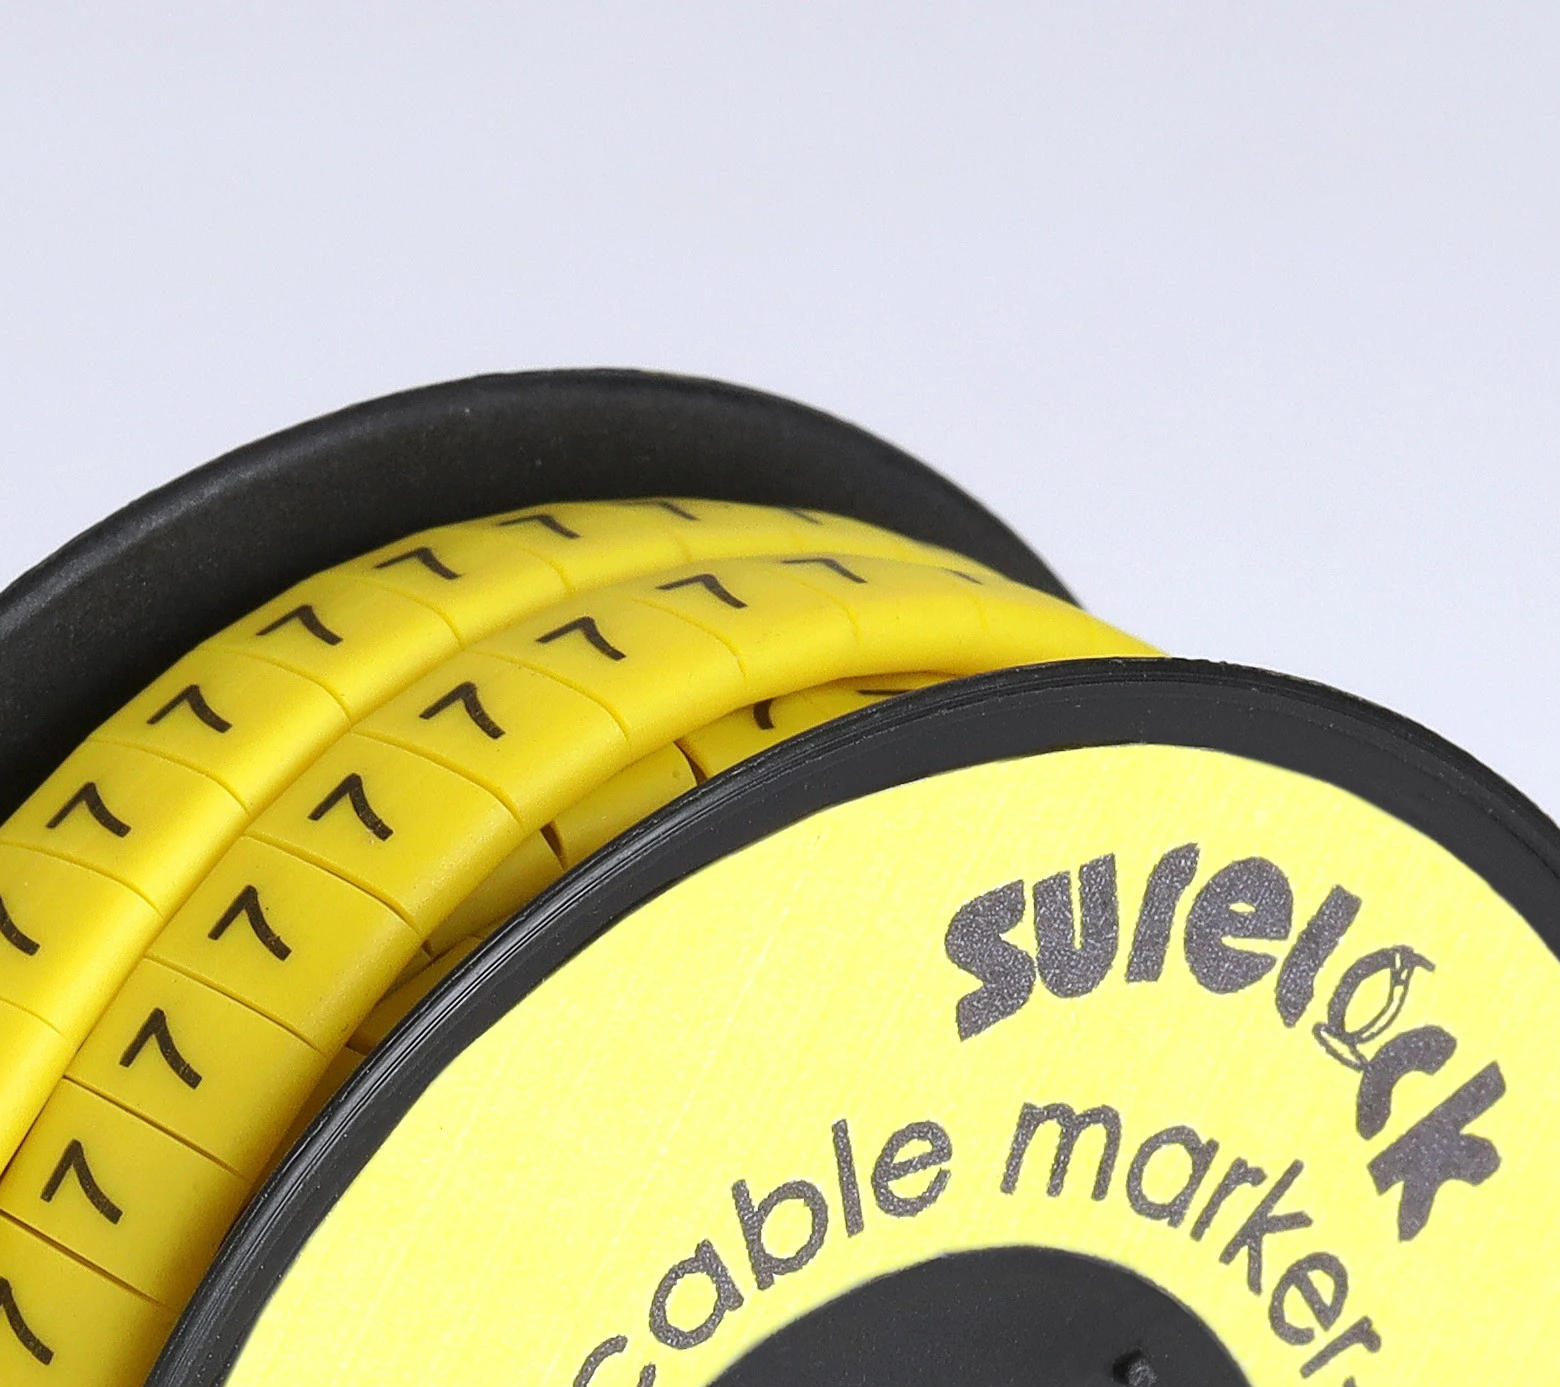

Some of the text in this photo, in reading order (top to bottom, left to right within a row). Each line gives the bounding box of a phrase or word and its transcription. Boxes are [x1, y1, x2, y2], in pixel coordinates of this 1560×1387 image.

[39, 1137, 124, 1226] 7
[118, 1006, 204, 1091] 7
[206, 883, 293, 963] 7
[306, 771, 395, 843] 7
[417, 680, 506, 741] 7
[534, 615, 628, 663] 7
[656, 572, 749, 610] 7
[781, 556, 867, 585] 7
[44, 780, 133, 839] 7
[145, 683, 234, 735] 7
[254, 602, 345, 647] 7
[370, 544, 463, 582] 7
[495, 513, 582, 540] 7
